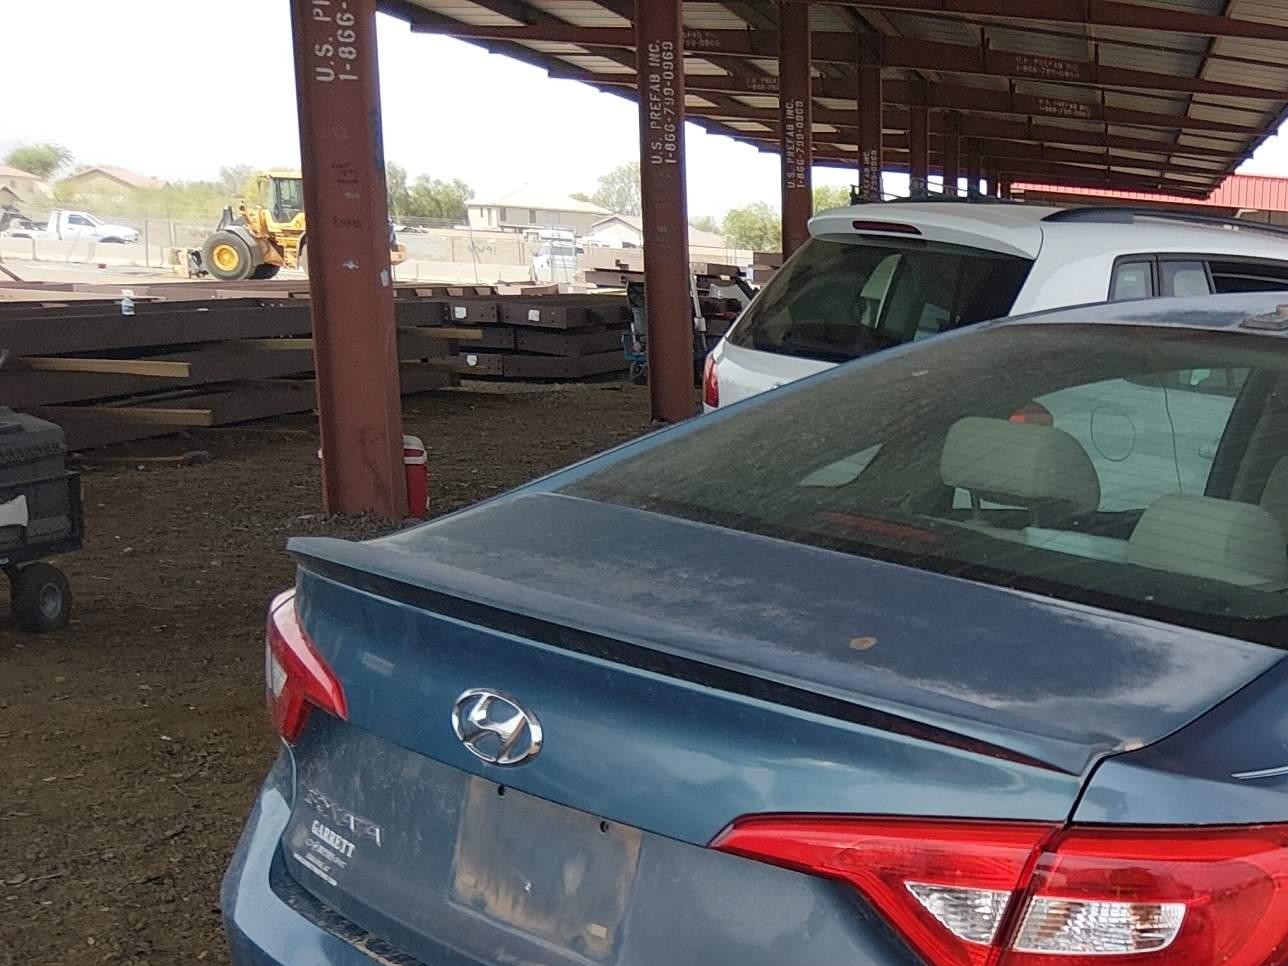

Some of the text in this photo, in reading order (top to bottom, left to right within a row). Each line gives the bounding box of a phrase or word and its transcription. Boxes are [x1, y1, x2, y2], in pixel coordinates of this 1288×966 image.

[314, 36, 336, 82] U.S.
[647, 39, 662, 67] INC.
[649, 74, 663, 130] PREFAB
[785, 123, 796, 165] PREFAB
[311, 819, 356, 858] GARRETT
